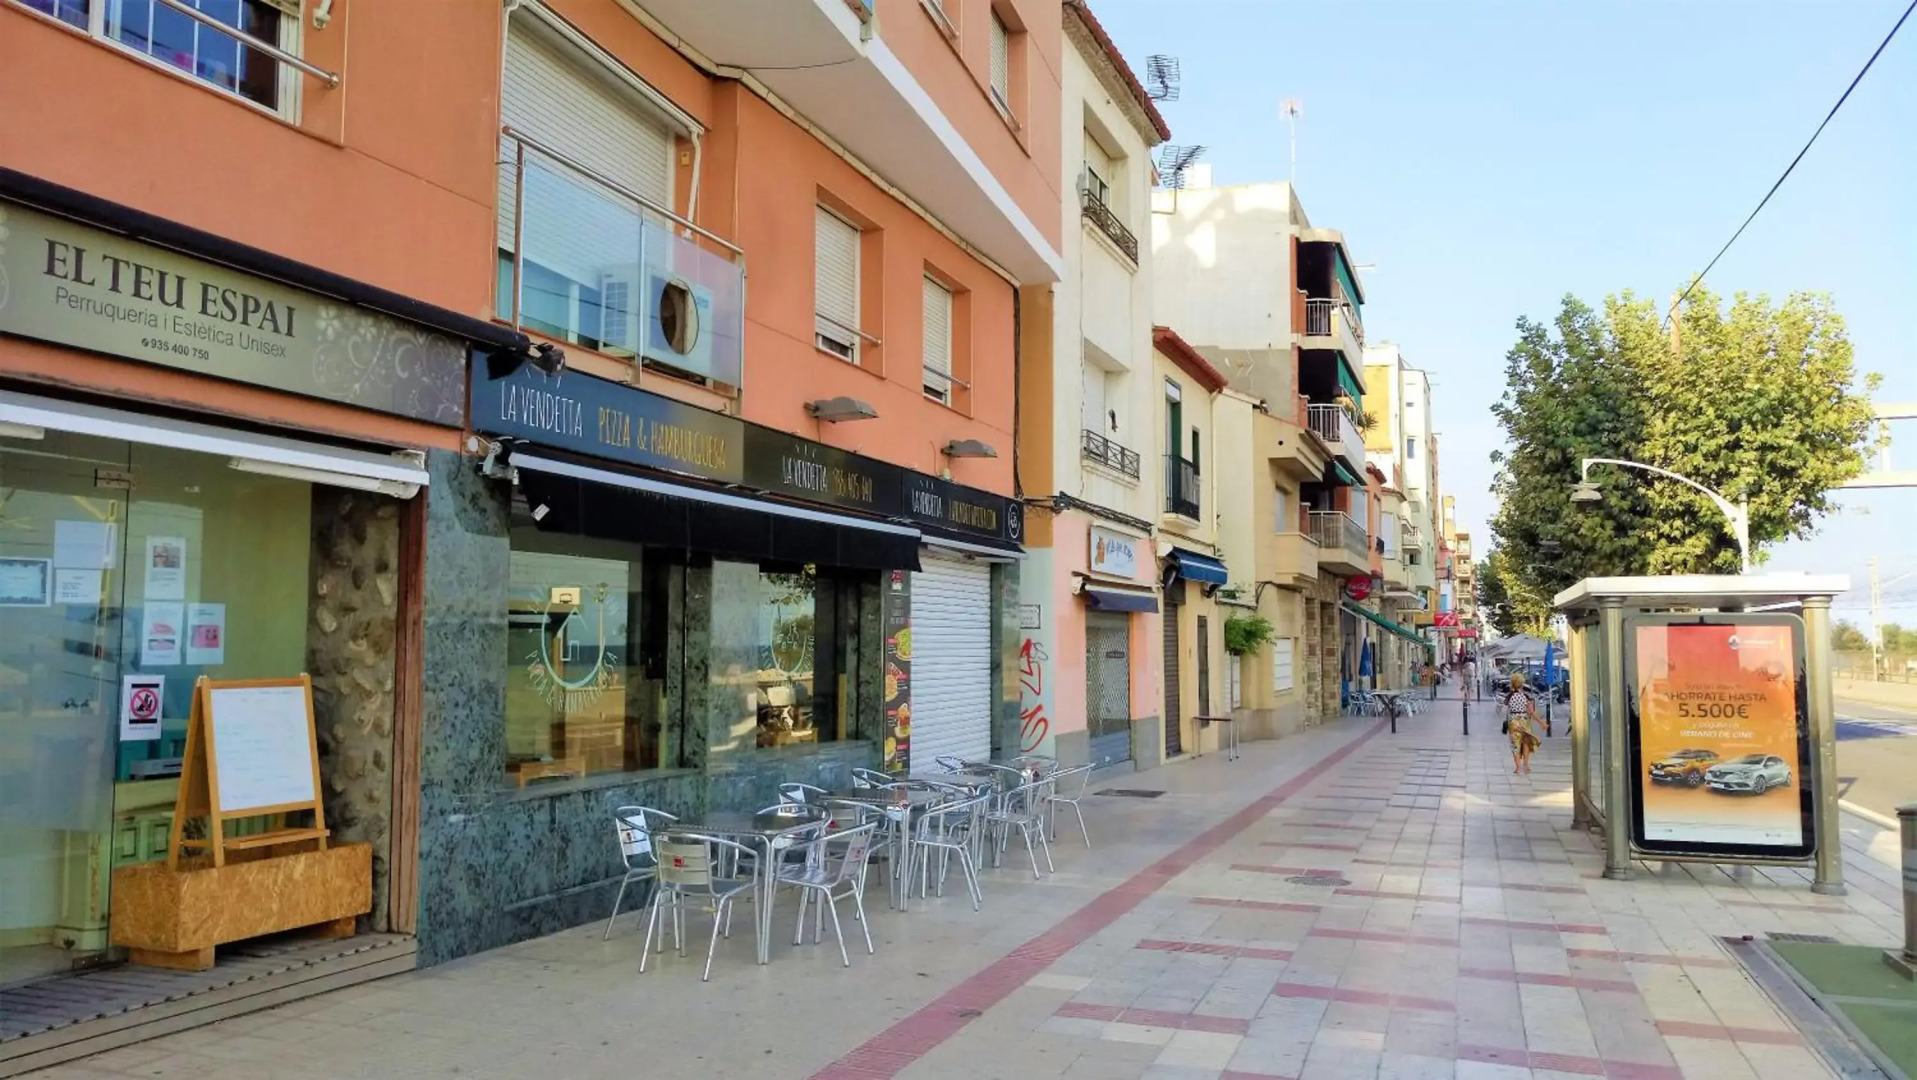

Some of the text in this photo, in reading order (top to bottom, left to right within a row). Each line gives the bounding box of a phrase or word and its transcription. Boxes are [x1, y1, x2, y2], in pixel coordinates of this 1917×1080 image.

[43, 238, 296, 339] EL TEU ESPAI
[56, 285, 158, 329] Perruqueria
[173, 314, 234, 347] Estètica
[239, 331, 287, 358] Unisex
[150, 338, 209, 361] 935 400 750
[501, 380, 583, 438] LA VENDETTA
[599, 406, 631, 449] PIZZA
[637, 416, 648, 452] &
[782, 454, 793, 485] LA
[793, 457, 828, 493] VENDETTA
[1728, 692, 1768, 703] HASTA
